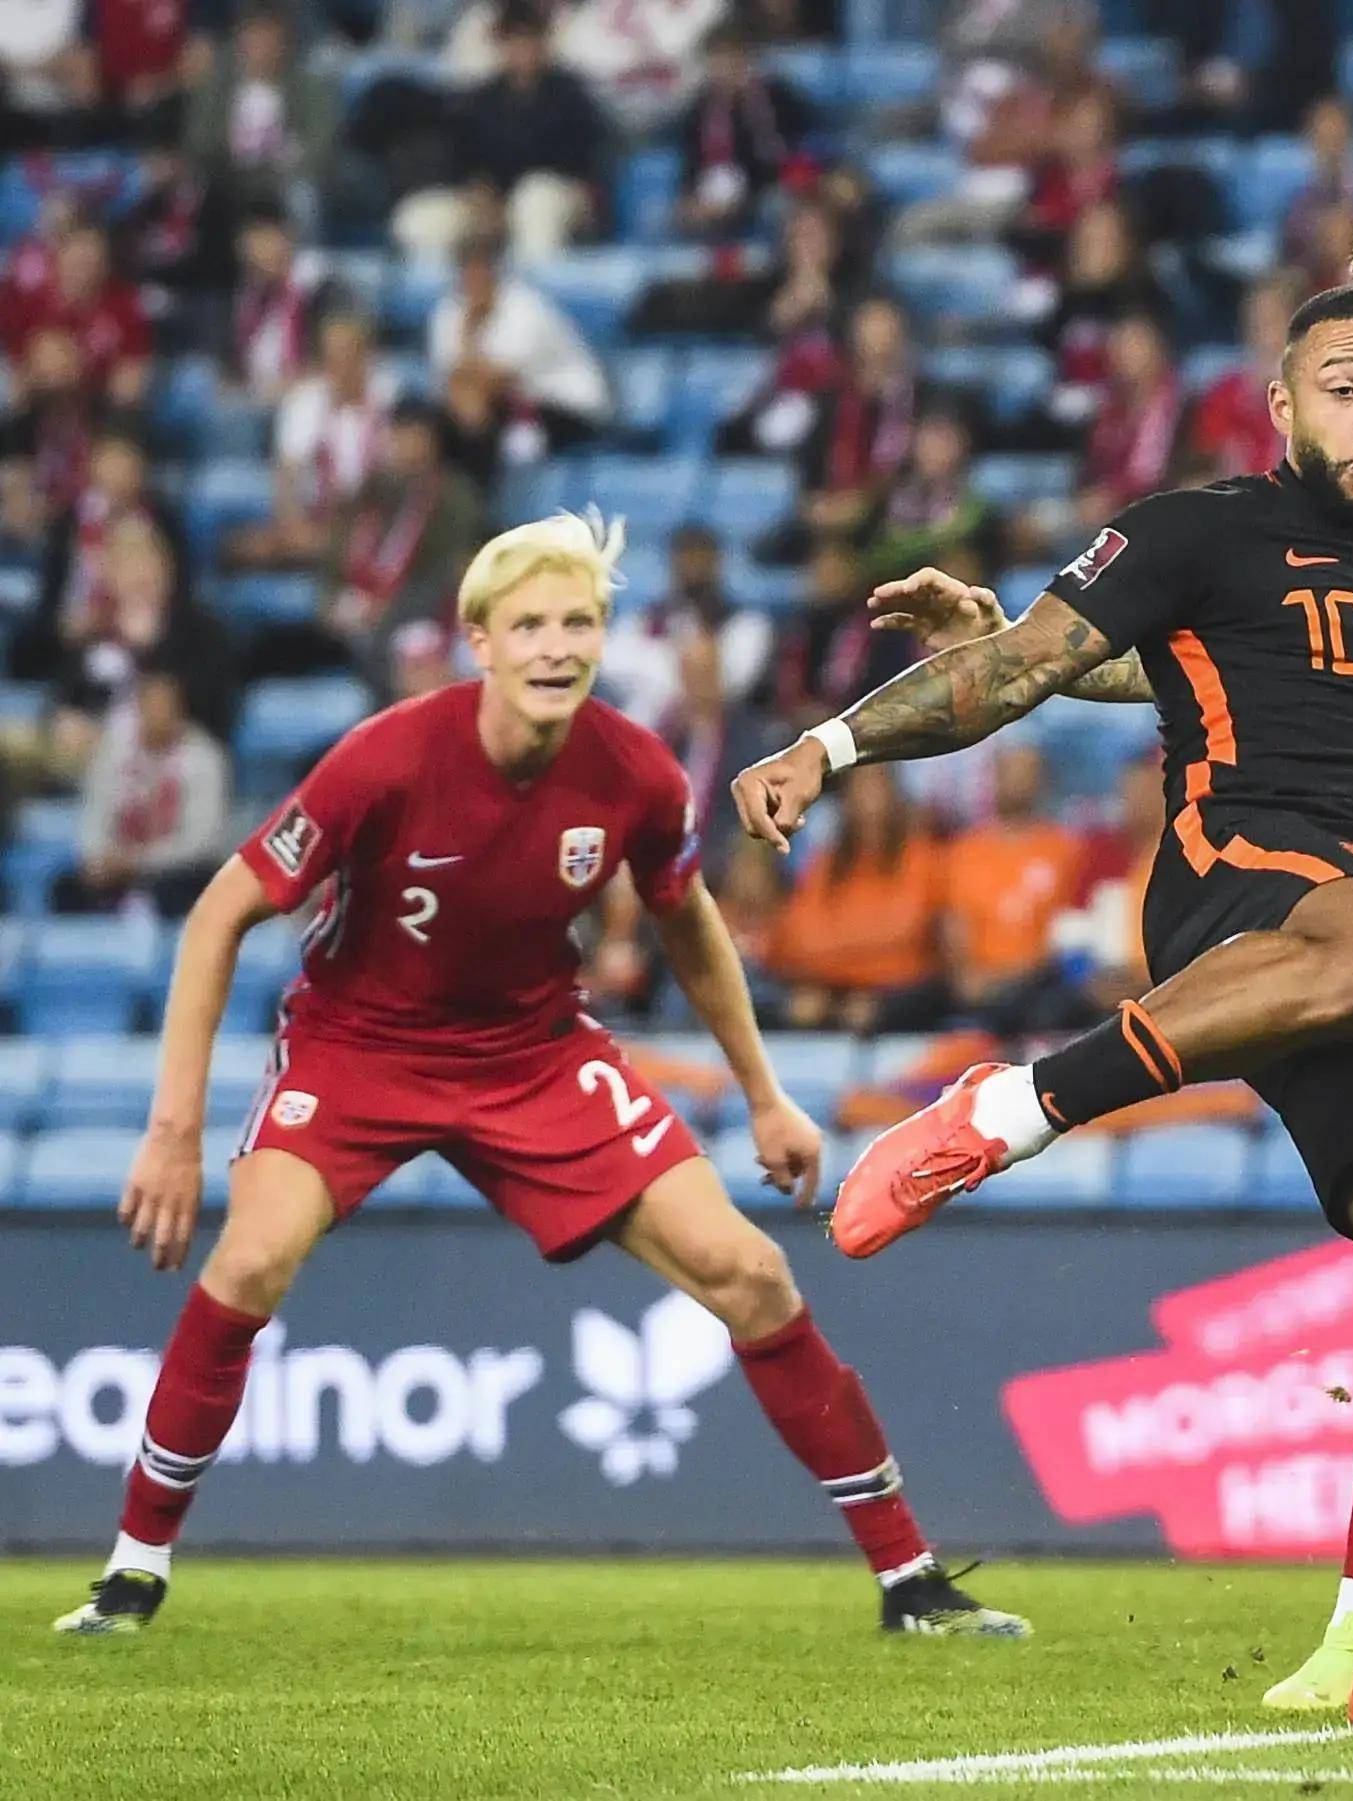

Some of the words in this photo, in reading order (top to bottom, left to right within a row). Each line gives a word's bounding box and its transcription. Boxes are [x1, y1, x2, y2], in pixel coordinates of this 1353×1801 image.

[398, 887, 439, 943] 2
[577, 1060, 652, 1128] 2
[0, 1315, 545, 1480] eqinor
